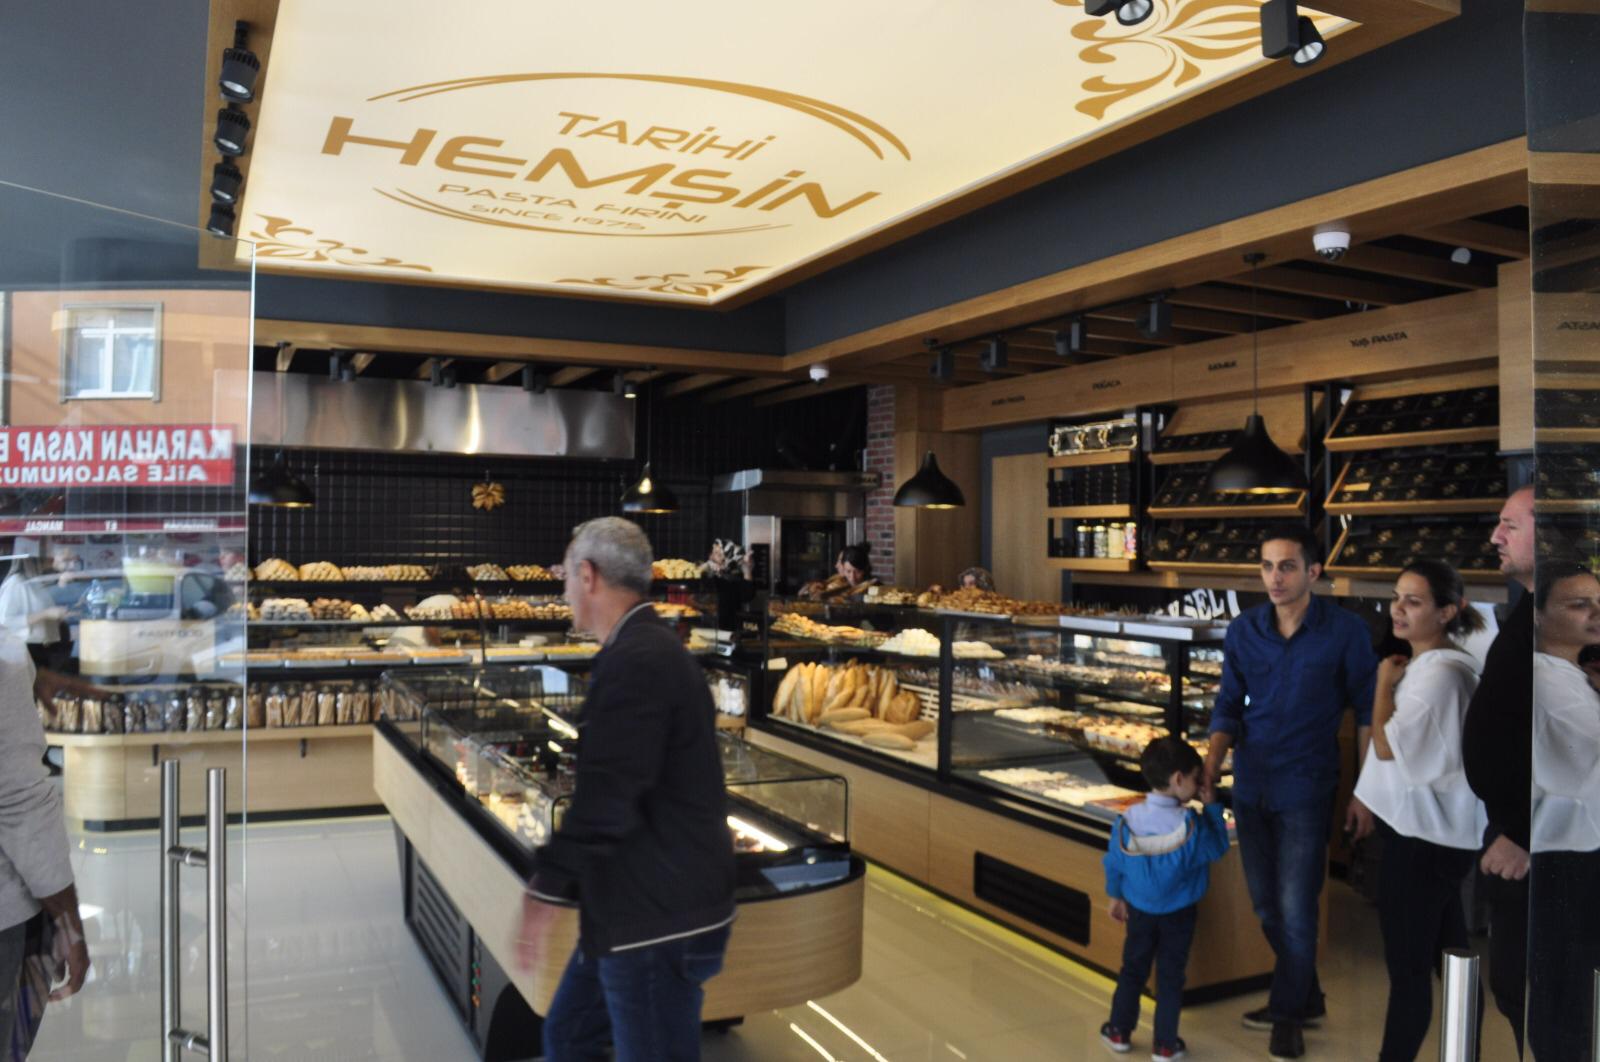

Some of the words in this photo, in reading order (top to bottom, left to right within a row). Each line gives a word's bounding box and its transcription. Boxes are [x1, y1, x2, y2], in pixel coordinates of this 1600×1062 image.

[437, 184, 577, 208] PASTA
[470, 204, 563, 221] SINCE
[573, 216, 647, 230] 1975
